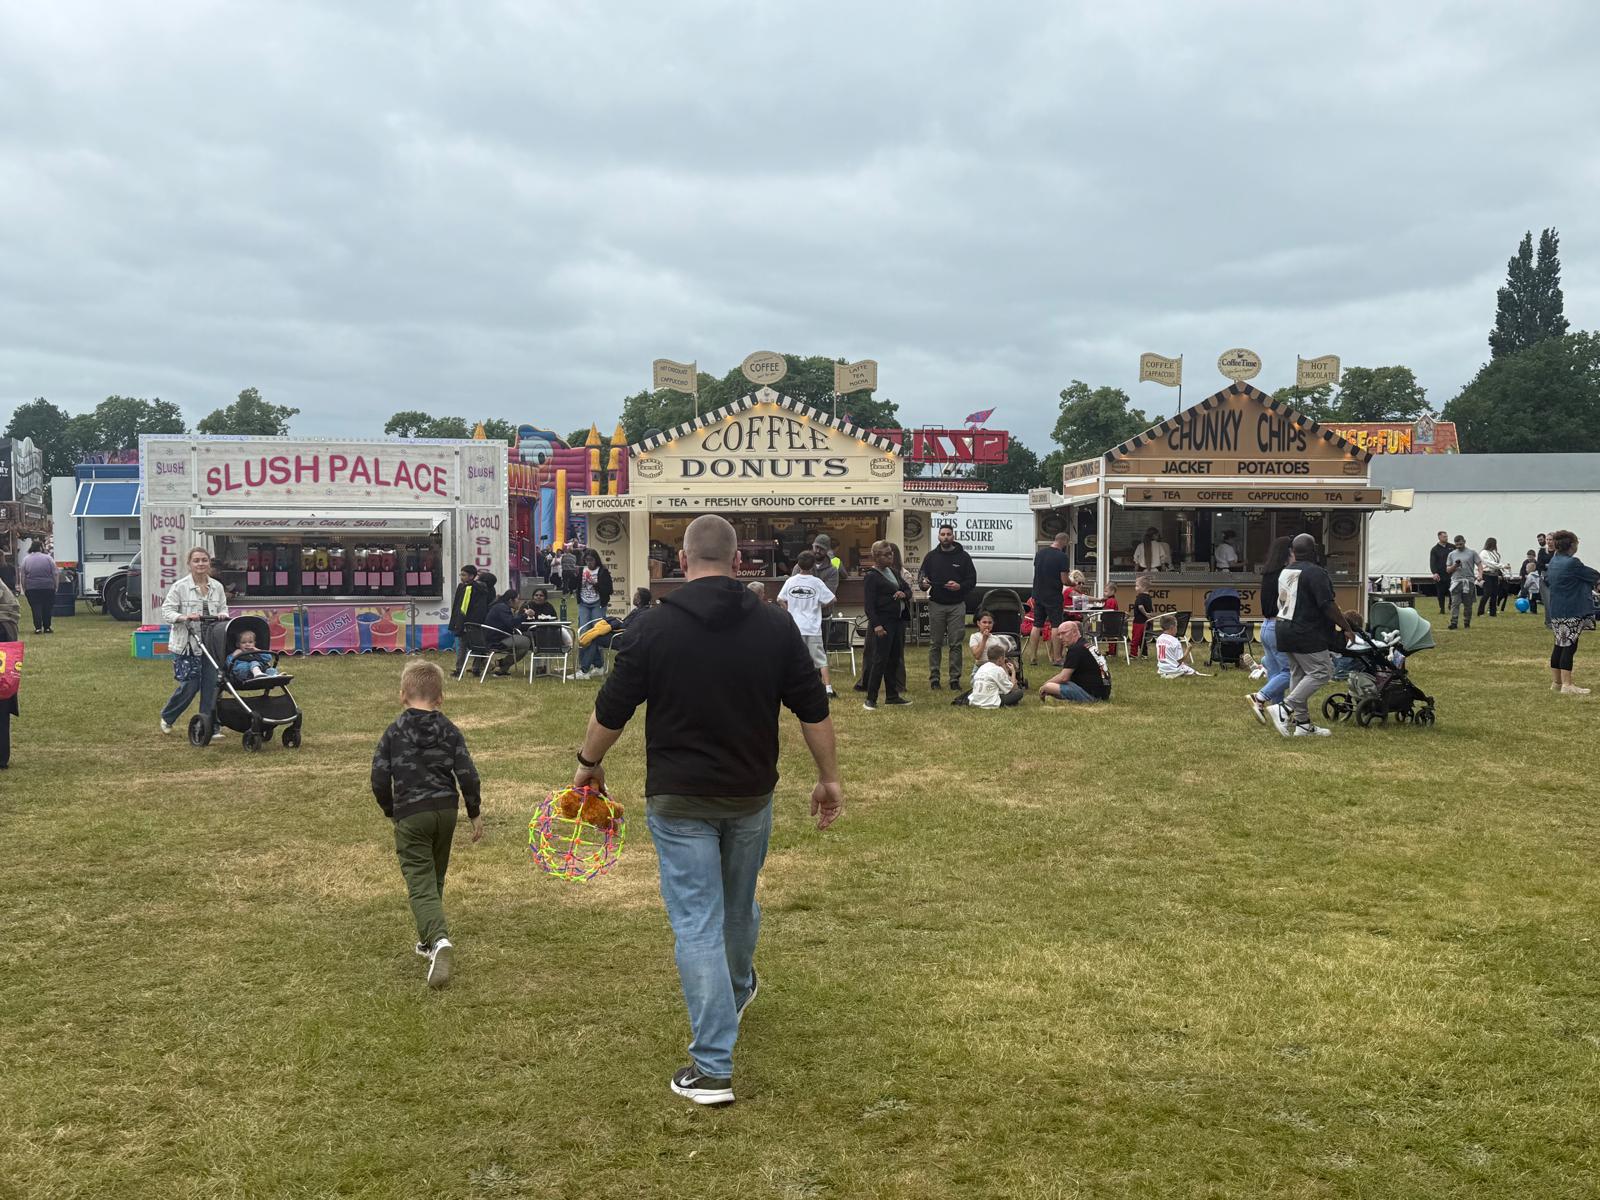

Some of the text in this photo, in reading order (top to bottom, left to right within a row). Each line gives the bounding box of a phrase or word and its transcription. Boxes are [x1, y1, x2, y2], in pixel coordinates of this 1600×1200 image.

[749, 362, 780, 372] COFFEE
[849, 364, 868, 374] LATTE
[1311, 362, 1328, 370] HOT
[1302, 372, 1336, 380] CHOCOLATE
[849, 378, 869, 387] MOCHA
[701, 415, 832, 452] COFFEE
[1168, 410, 1307, 452] CHUNKY CHIPS
[1367, 436, 1378, 447] OF
[1377, 428, 1412, 454] FUN
[156, 461, 185, 475] SLUSH
[468, 465, 496, 480] SLUSH
[680, 458, 850, 478] DONUTS
[1162, 461, 1310, 474] JACKET POTATOES
[206, 455, 448, 497] SLUSH PALACE
[1162, 490, 1343, 501] TEA COFFEE CAPPUCCINO TEA
[582, 498, 635, 509] HOT CHOCOLATE
[668, 497, 880, 507] TEA FRESHLY GROUND COFFEE LATTE
[911, 497, 945, 507] CAPPUCCINO
[150, 512, 185, 532] ICE COLD
[233, 519, 262, 527] Nice
[297, 519, 313, 527] Ice
[353, 519, 388, 528] Slush
[466, 513, 500, 533] ICE COLD
[931, 518, 1013, 531] URTIS CATERING
[954, 530, 994, 541] LESUIRE
[475, 536, 492, 574] SLU
[737, 569, 766, 577] DONUTS
[1149, 589, 1170, 598] CKET
[313, 612, 352, 639] SLUSH
